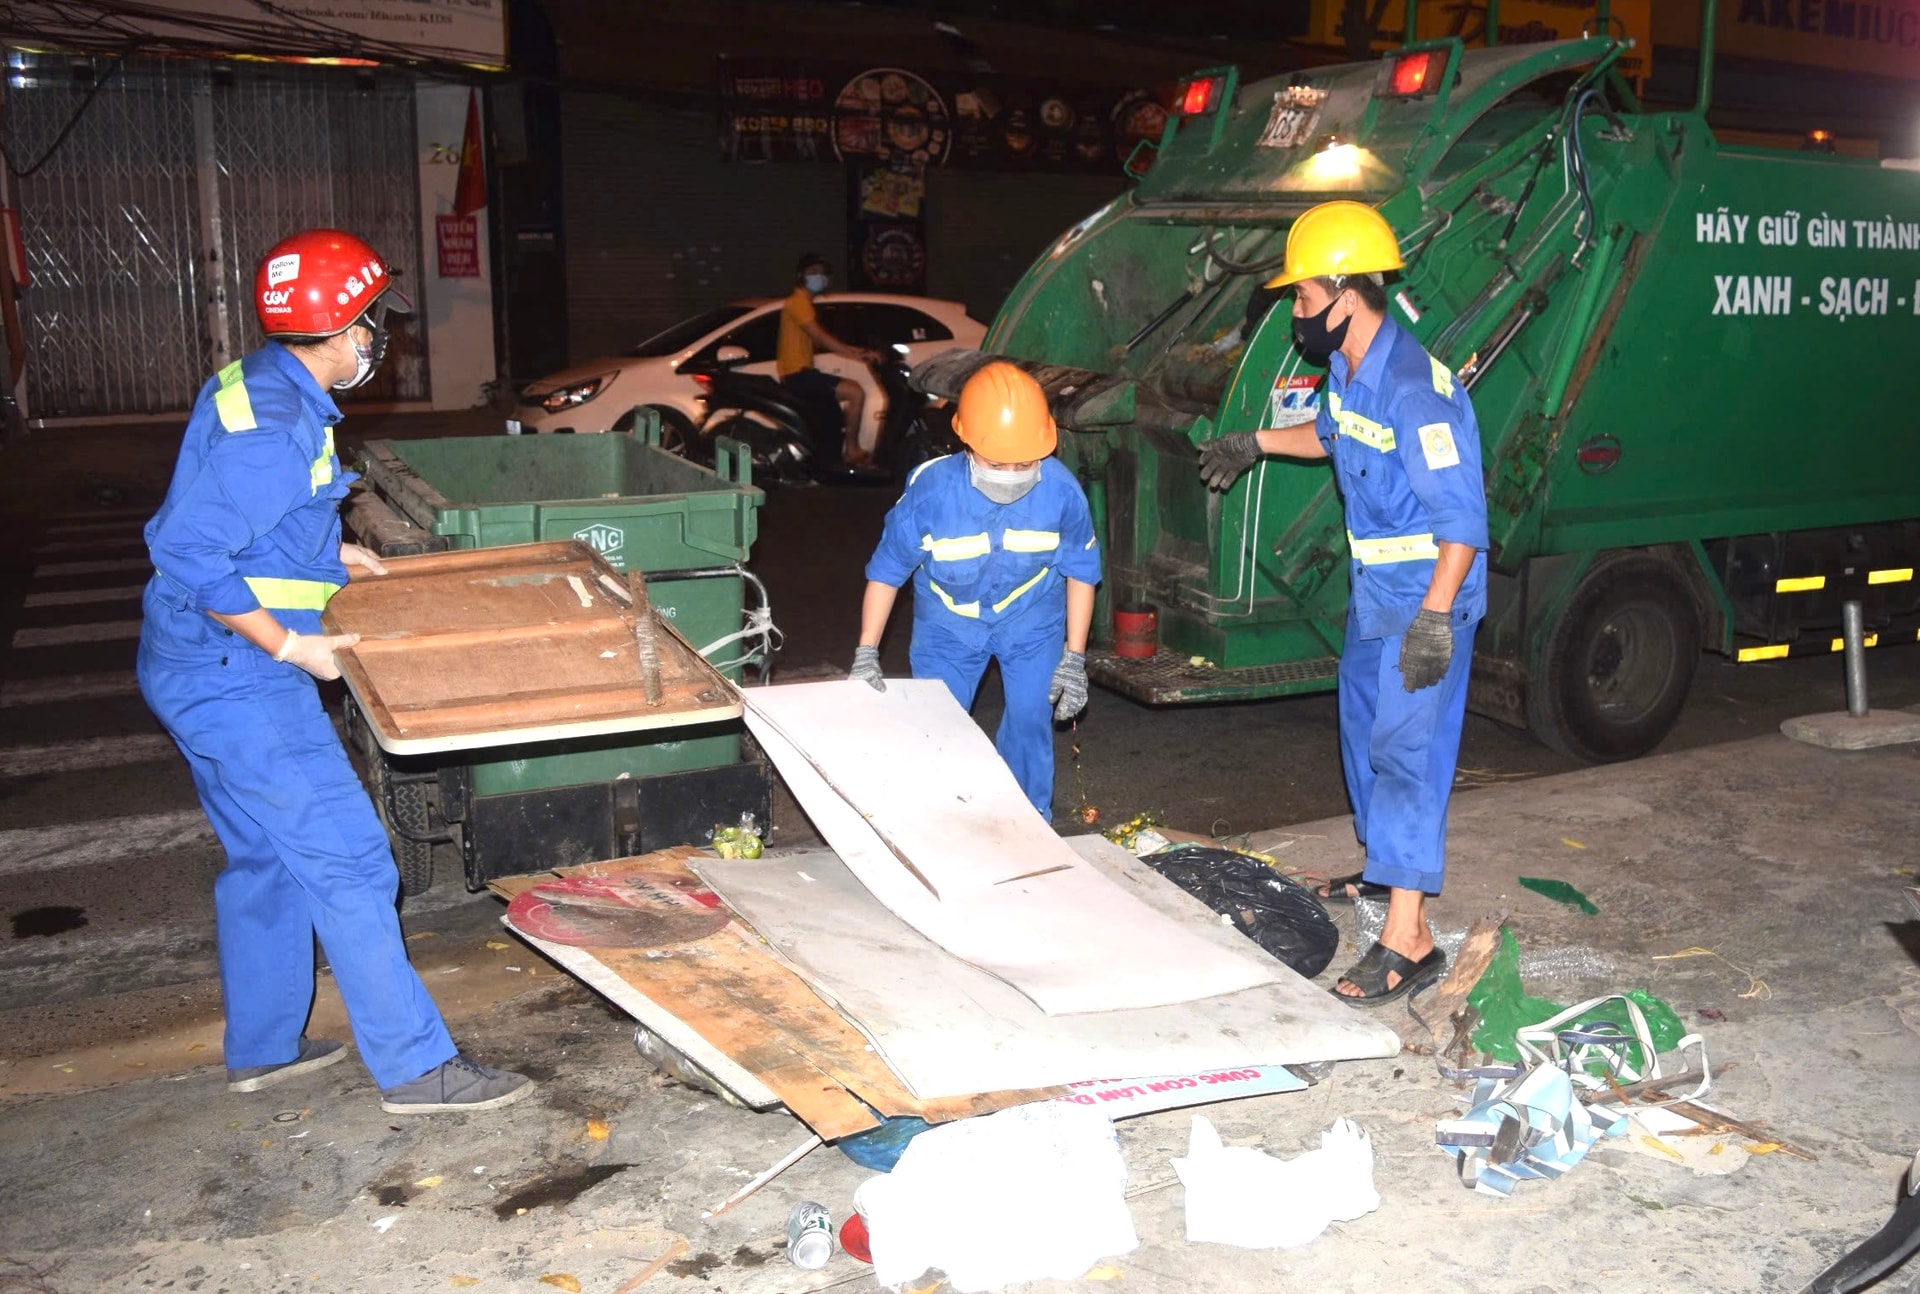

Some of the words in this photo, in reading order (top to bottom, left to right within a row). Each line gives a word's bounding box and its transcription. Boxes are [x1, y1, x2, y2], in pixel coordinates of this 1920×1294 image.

[1696, 207, 1749, 244] HÃY
[1758, 210, 1800, 246] GIỮ
[1807, 212, 1846, 247] GÌN
[272, 260, 295, 270] Follow
[272, 271, 282, 279] Me
[264, 290, 289, 305] CGV
[1712, 275, 1792, 315] XANH
[1819, 277, 1889, 322] SẠCH
[1147, 1077, 1198, 1093] CON
